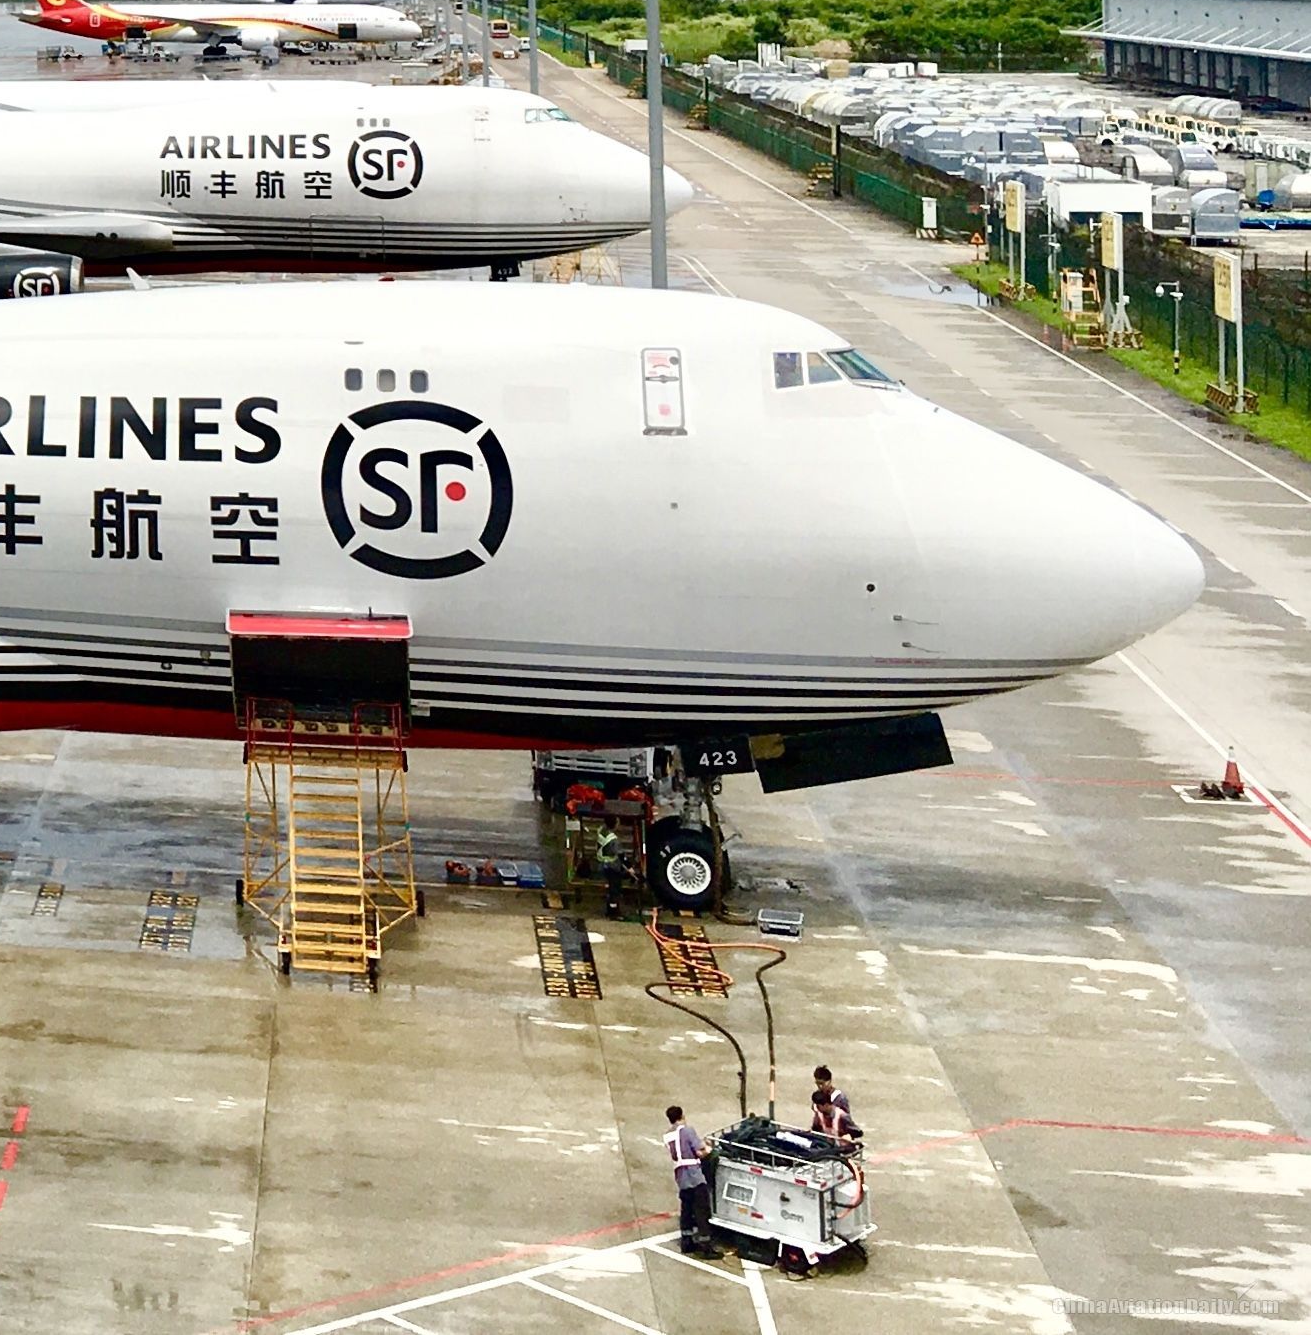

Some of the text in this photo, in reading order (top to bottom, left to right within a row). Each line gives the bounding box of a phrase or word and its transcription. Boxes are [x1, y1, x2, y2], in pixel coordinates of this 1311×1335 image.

[160, 133, 332, 160] AIRLINES
[362, 148, 408, 182] SF
[160, 169, 333, 200] 顺丰航空
[359, 447, 474, 534] SF
[699, 750, 738, 767] 423
